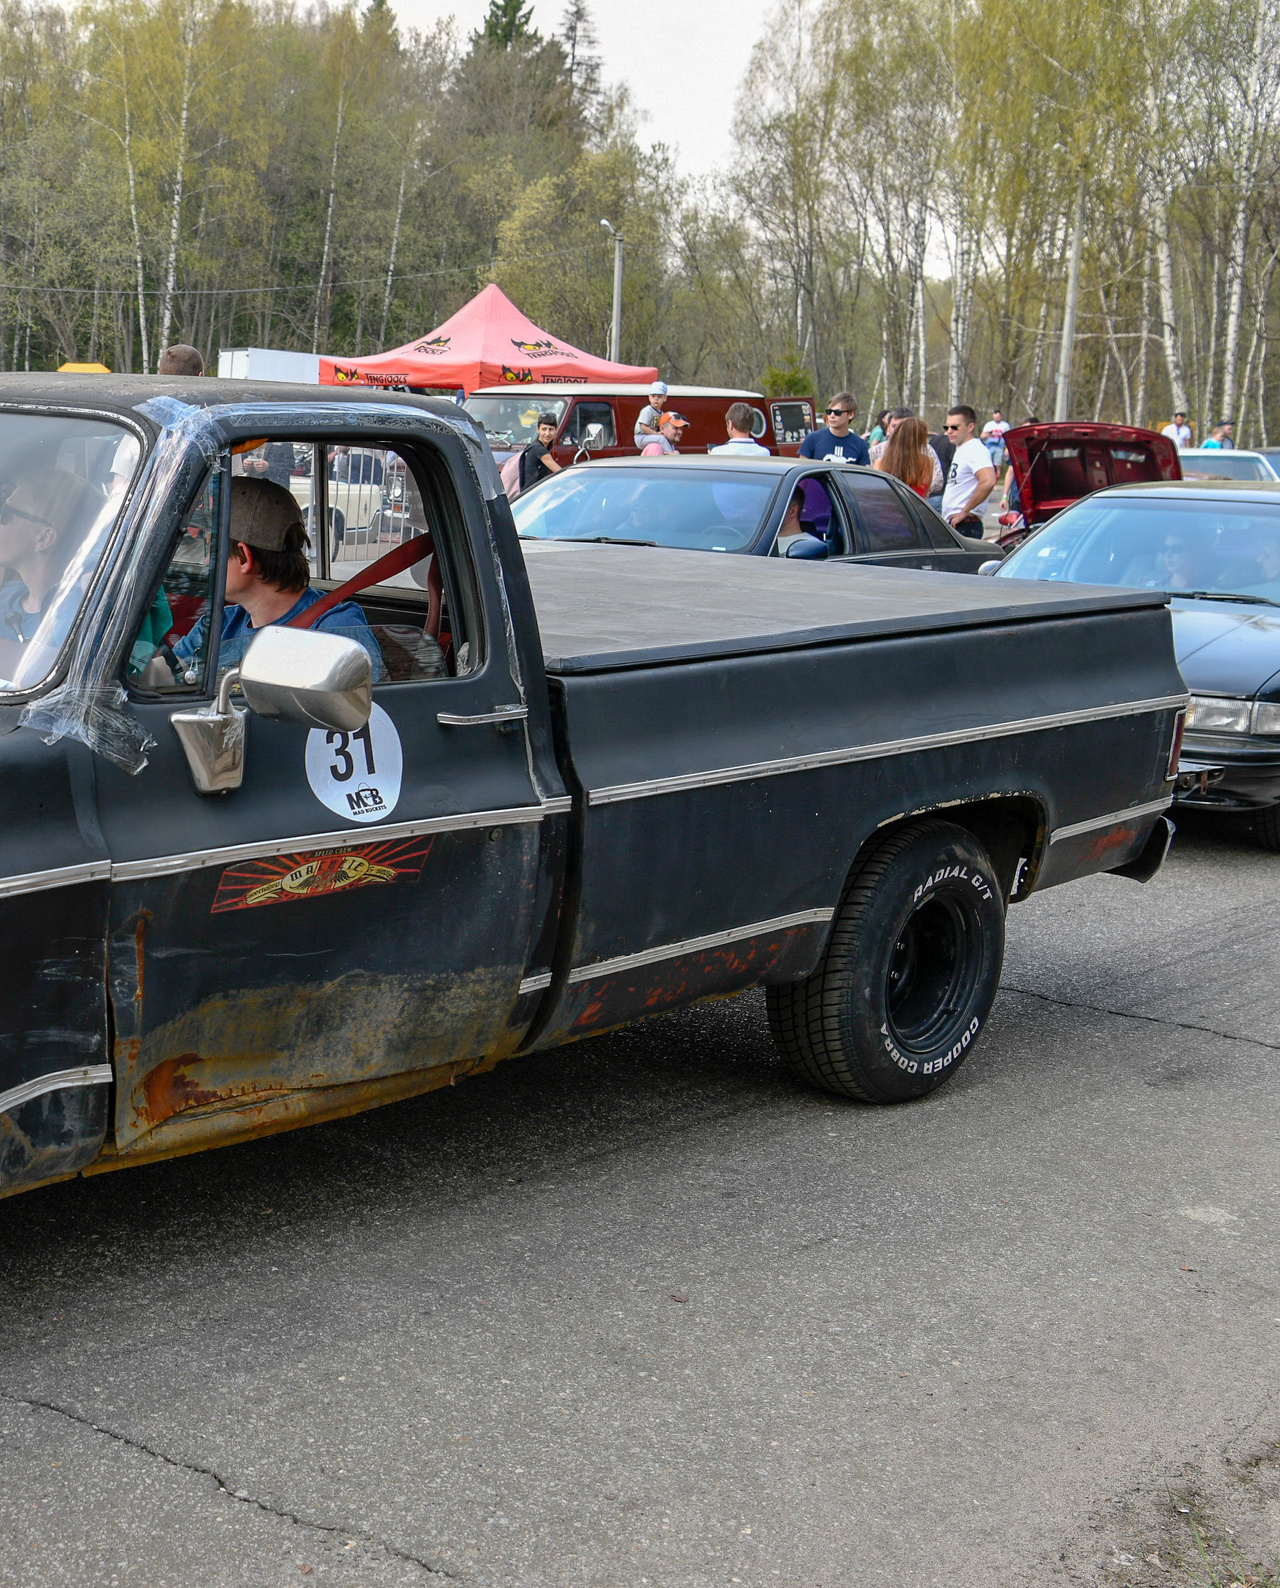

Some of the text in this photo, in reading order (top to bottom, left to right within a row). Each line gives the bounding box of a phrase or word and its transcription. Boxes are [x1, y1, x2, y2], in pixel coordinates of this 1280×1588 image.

[365, 373, 409, 384] TENGTOOLS
[325, 719, 376, 782] 31
[365, 805, 387, 814] BUCKETS
[314, 849, 334, 857] SPEED
[913, 865, 993, 903] RADIAL G/T
[880, 1016, 980, 1075] COOPER COBRA
